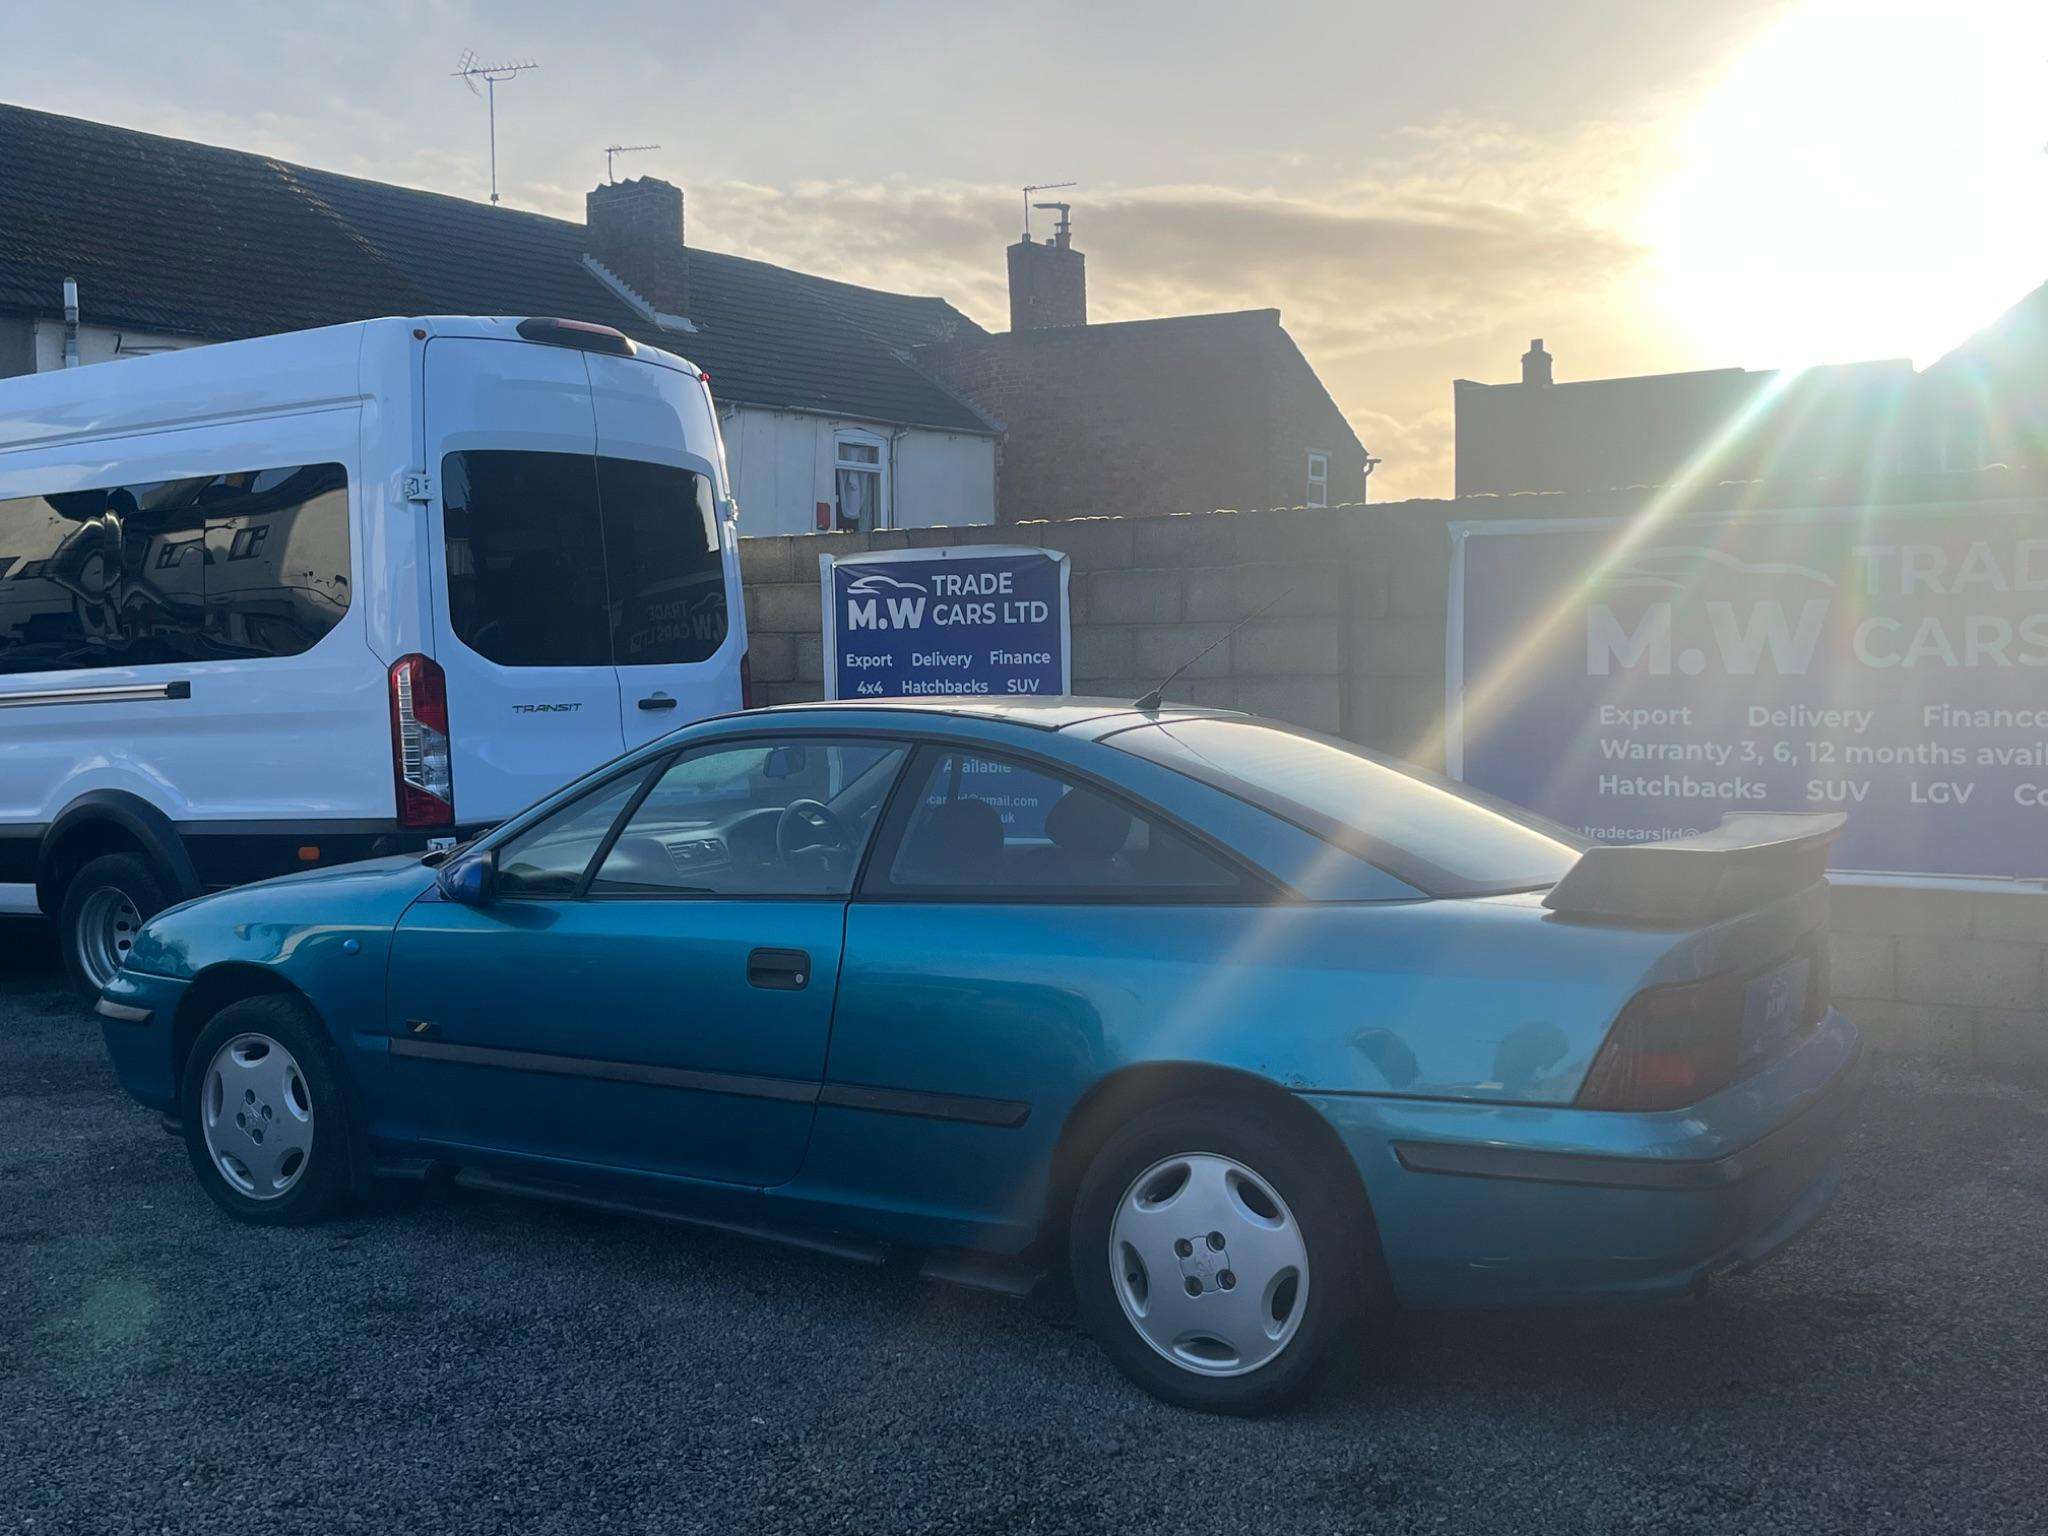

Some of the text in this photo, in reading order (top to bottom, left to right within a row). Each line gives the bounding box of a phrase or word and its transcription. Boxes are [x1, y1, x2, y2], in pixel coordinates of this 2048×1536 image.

[931, 572, 1013, 597] TRADE
[847, 597, 926, 631] M.W
[932, 600, 1049, 626] CARS LTD
[1586, 599, 1832, 676] M.W
[846, 650, 1051, 670] Export Delivery Finance
[857, 678, 1040, 695] 4x4 Hatchbacks SUV
[511, 703, 582, 713] TRANSIT
[1600, 703, 2048, 733] Export Delivery Finance
[1600, 739, 1733, 766] Warranty
[1740, 741, 1765, 766] 3,
[1773, 741, 1798, 767] 6,
[1806, 741, 1836, 763] 12
[1845, 741, 1967, 765] months
[1599, 774, 1767, 799] Hatchbacks
[1806, 780, 1871, 802] SUV
[1910, 781, 1976, 804] LGV
